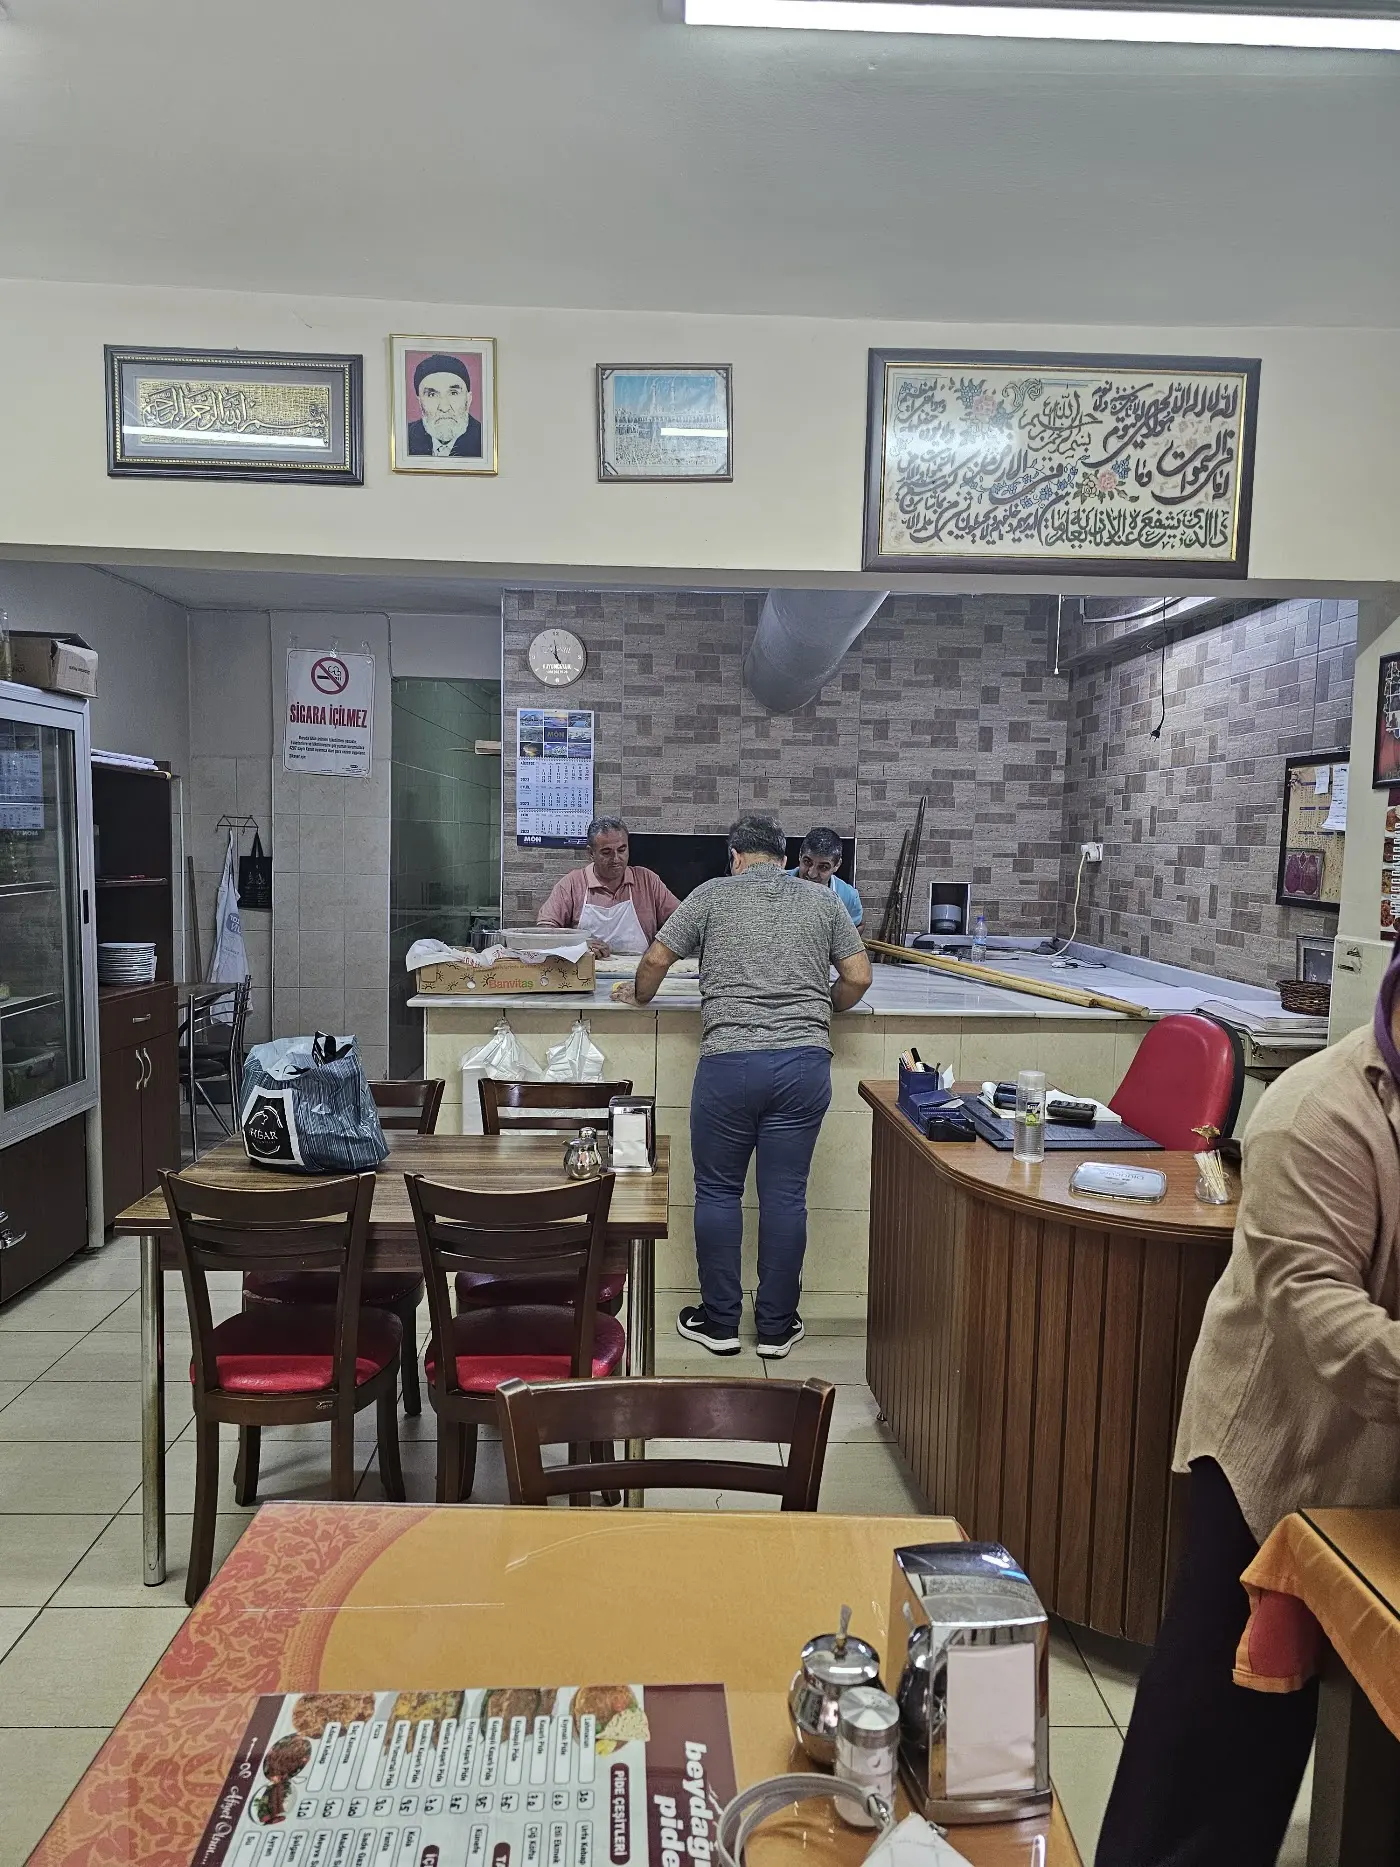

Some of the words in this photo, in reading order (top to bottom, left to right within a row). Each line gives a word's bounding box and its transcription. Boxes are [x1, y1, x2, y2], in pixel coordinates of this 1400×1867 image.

[290, 702, 326, 725] SİGARA
[329, 704, 368, 729] İÇİLMEZ
[326, 1725, 337, 1743] Adana
[373, 1724, 383, 1739] Pizza
[583, 1718, 591, 1748] Lahmacun
[318, 1745, 332, 1764] Kebap
[511, 1748, 520, 1762] Pide
[560, 1742, 568, 1755] Pide
[384, 1774, 394, 1786] Pide
[411, 1770, 420, 1783] Pide
[435, 1769, 445, 1782] Pide
[459, 1767, 468, 1781] Pide
[484, 1768, 492, 1781] Pide
[614, 1770, 626, 1794] PİDE
[219, 1786, 244, 1820] Afiyet
[554, 1826, 563, 1837] Etli
[580, 1825, 590, 1840] Urfa
[612, 1796, 627, 1856] ÇEŞİTLERİ
[654, 1794, 685, 1867] pide
[245, 1836, 257, 1846] Su
[265, 1835, 278, 1857] Ayran
[287, 1834, 302, 1862] Şalgam
[313, 1834, 327, 1858] Meyve
[335, 1833, 349, 1858] Maden
[359, 1833, 371, 1850] Sade
[381, 1832, 393, 1852] Fanta
[405, 1831, 415, 1847] Kola
[471, 1828, 482, 1854] Künefe
[527, 1841, 537, 1861] Köfte
[552, 1839, 562, 1864] Ekmek
[578, 1842, 589, 1866] Kebap
